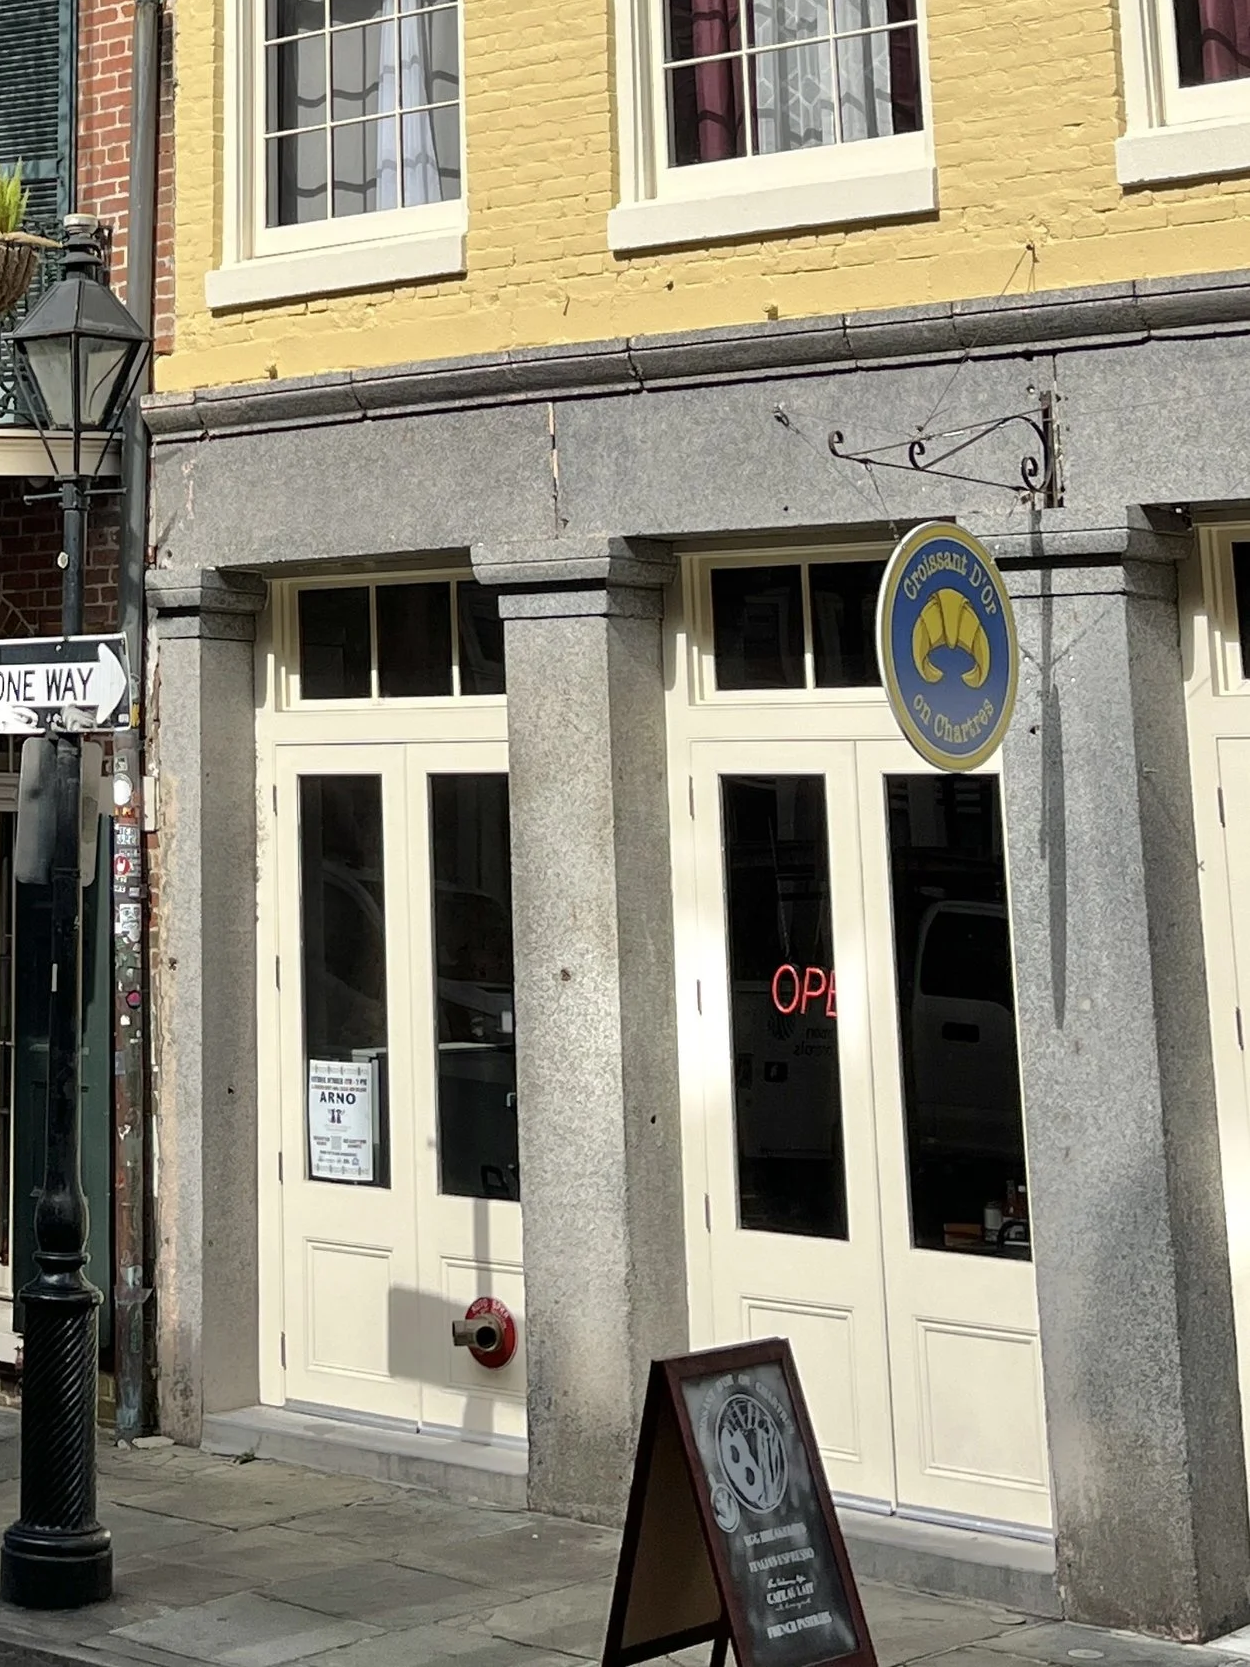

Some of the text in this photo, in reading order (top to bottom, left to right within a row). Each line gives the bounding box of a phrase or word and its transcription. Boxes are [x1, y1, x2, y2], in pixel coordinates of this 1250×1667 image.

[903, 550, 998, 616] Croissant D'Or
[45, 667, 94, 701] WAY
[913, 693, 994, 744] on Chartres
[772, 963, 838, 1018] OPE
[319, 1091, 357, 1105] ARNO
